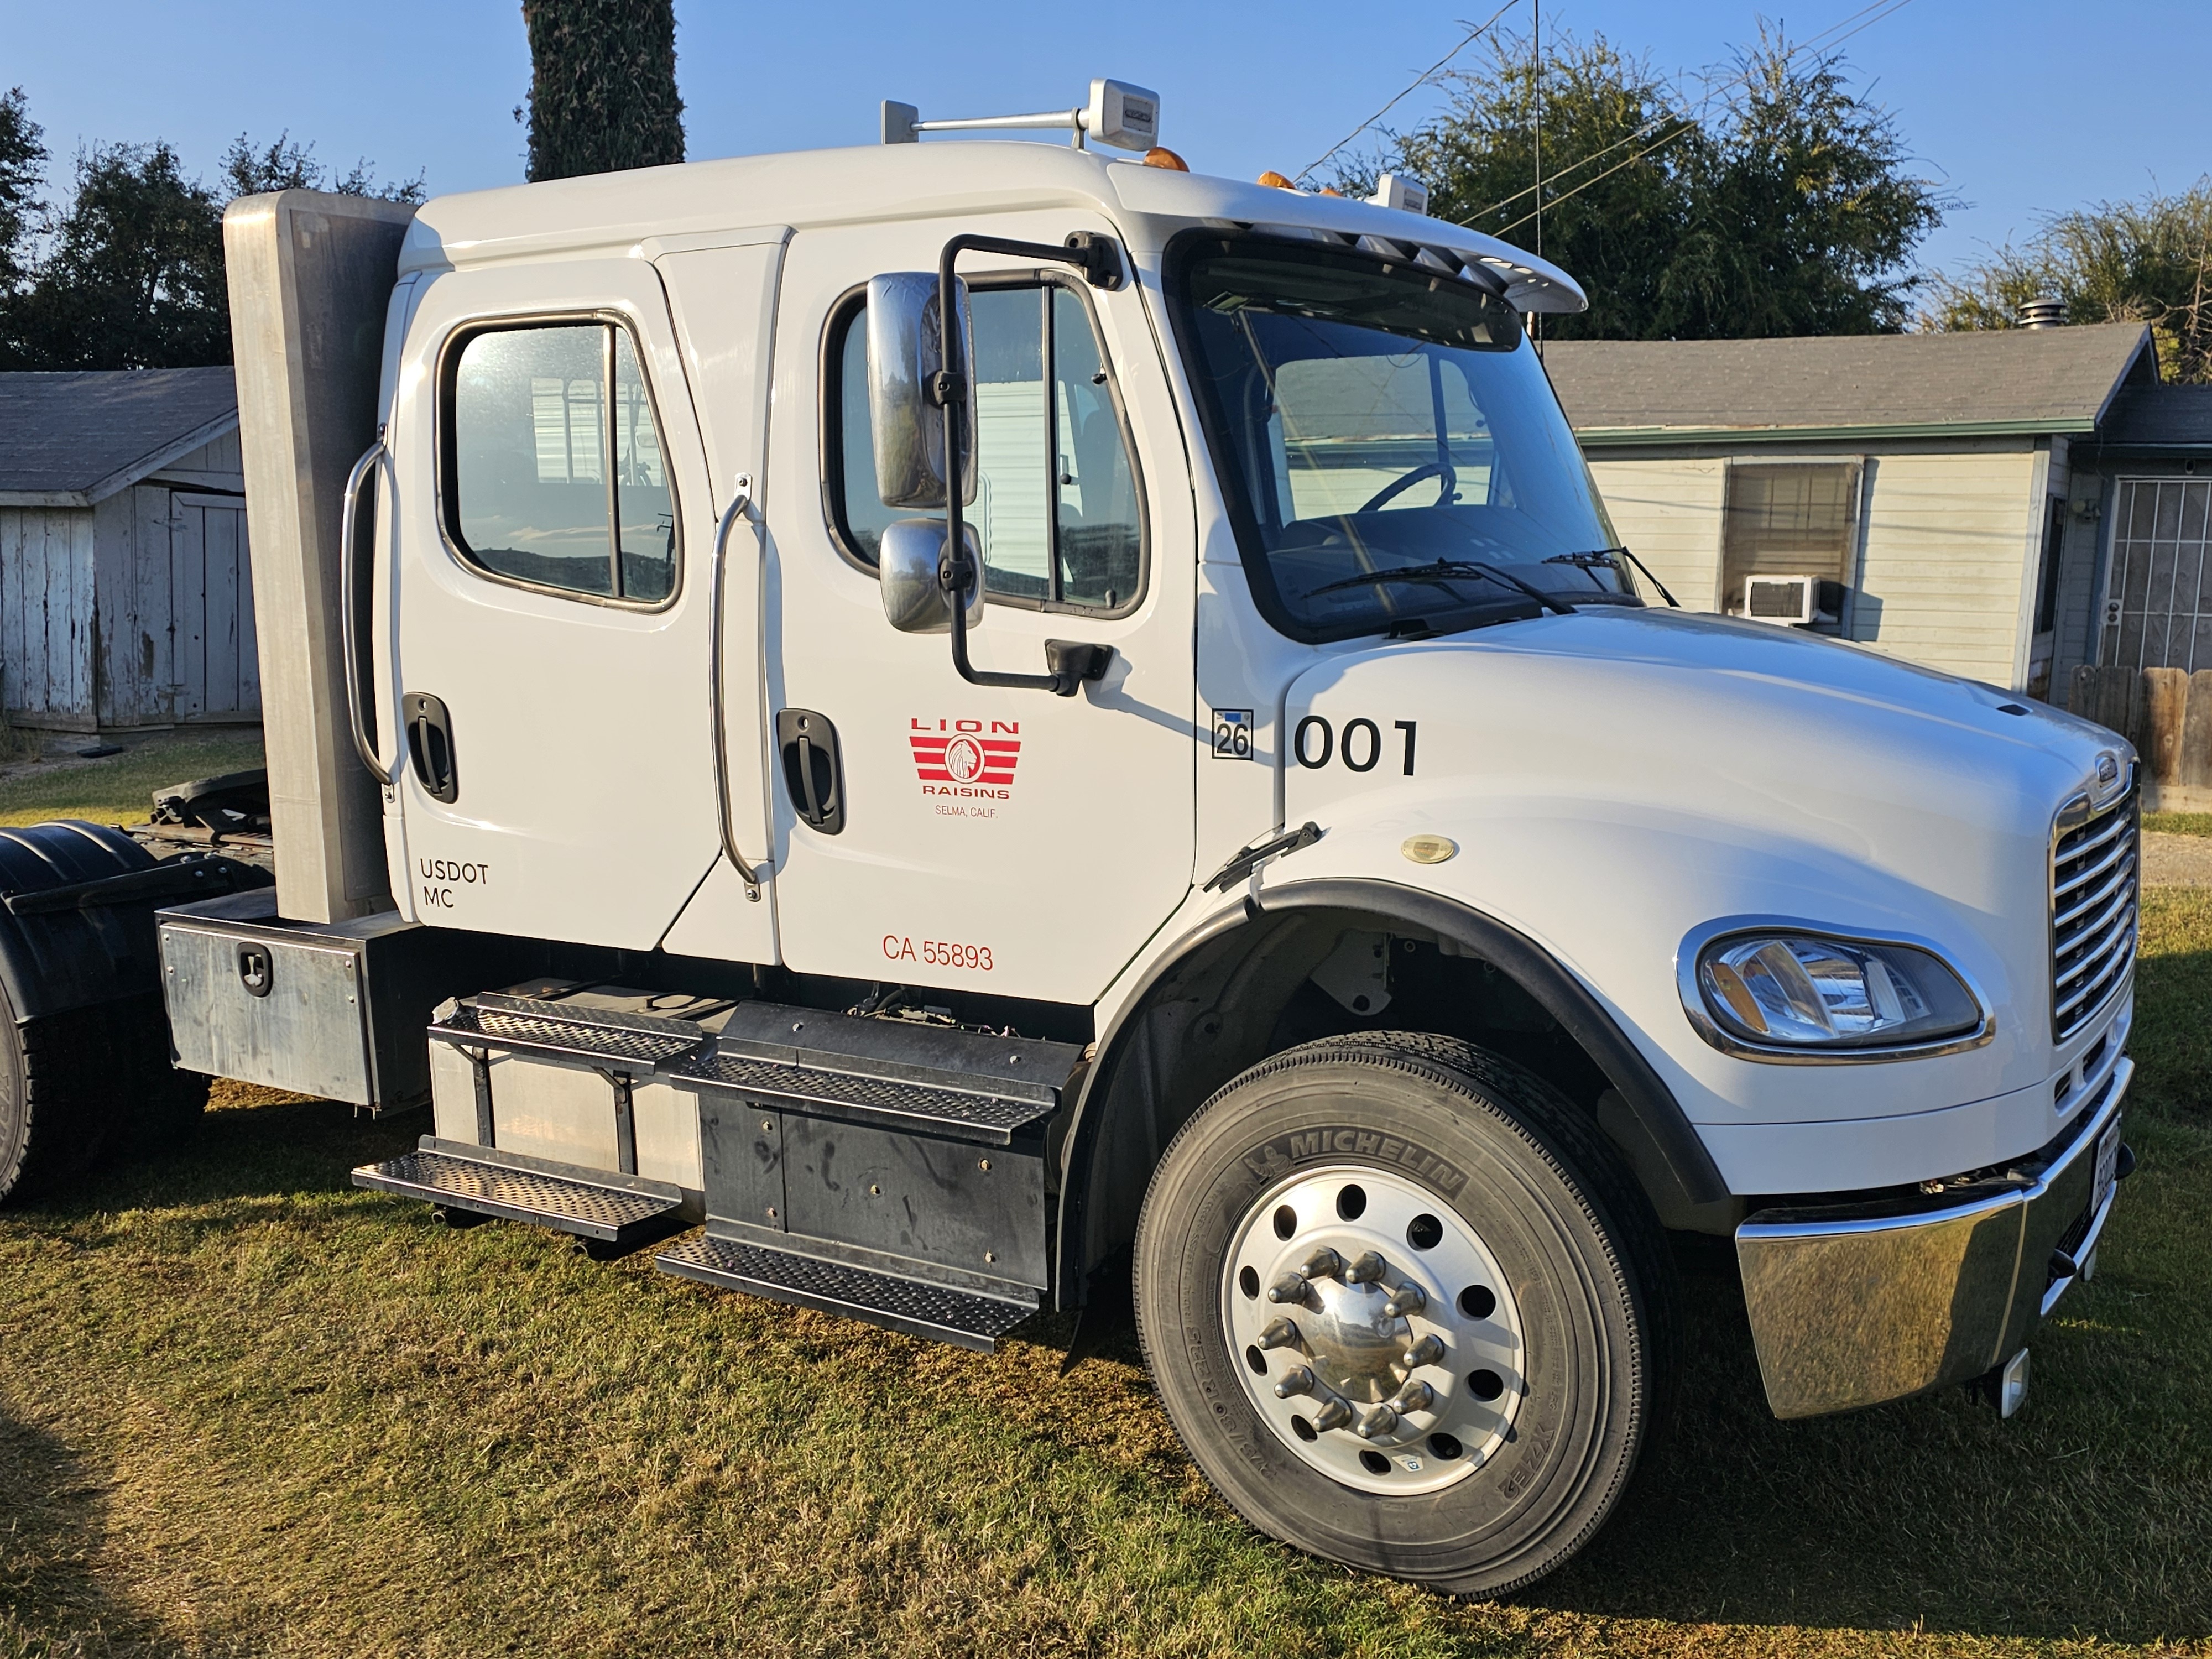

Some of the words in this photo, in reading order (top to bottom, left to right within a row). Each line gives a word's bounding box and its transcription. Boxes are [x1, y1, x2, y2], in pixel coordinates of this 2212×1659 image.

[911, 718, 1019, 734] LION
[1217, 723, 1249, 755] 26
[1295, 716, 1417, 776] 001
[922, 785, 1010, 800] RAISINS
[935, 805, 968, 817] SELMA,
[970, 807, 998, 819] CALIF.
[420, 858, 488, 885] USDOT
[424, 886, 454, 908] MC
[883, 935, 917, 962] CA
[924, 941, 993, 971] 55893
[1289, 1130, 1464, 1191] MICHELIN
[1497, 1422, 1555, 1500] XZE2
